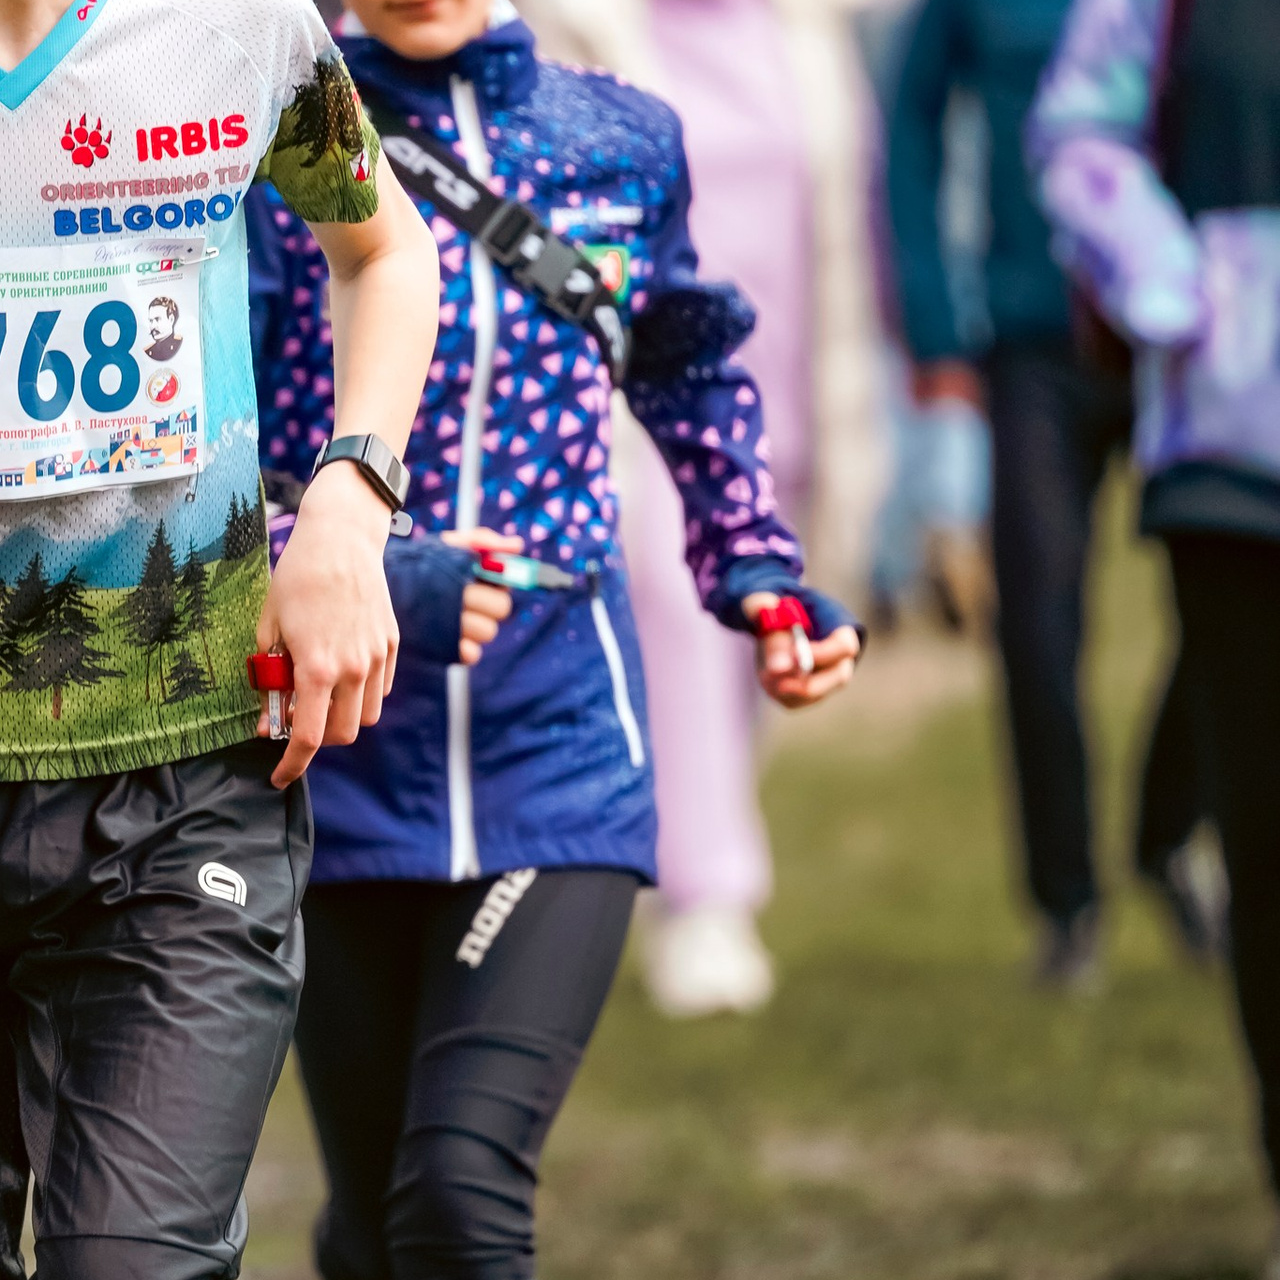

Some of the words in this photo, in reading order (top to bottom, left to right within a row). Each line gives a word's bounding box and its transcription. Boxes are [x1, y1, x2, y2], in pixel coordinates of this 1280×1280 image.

[136, 114, 249, 162] IRBIS
[41, 171, 210, 202] ORIENTEERING
[53, 190, 242, 236] BELGORO
[53, 263, 131, 281] СОРЕВНОВАНИЯ
[10, 282, 108, 298] ОРИЕНТИРОВАНИЮ
[89, 415, 148, 430] Пастухова
